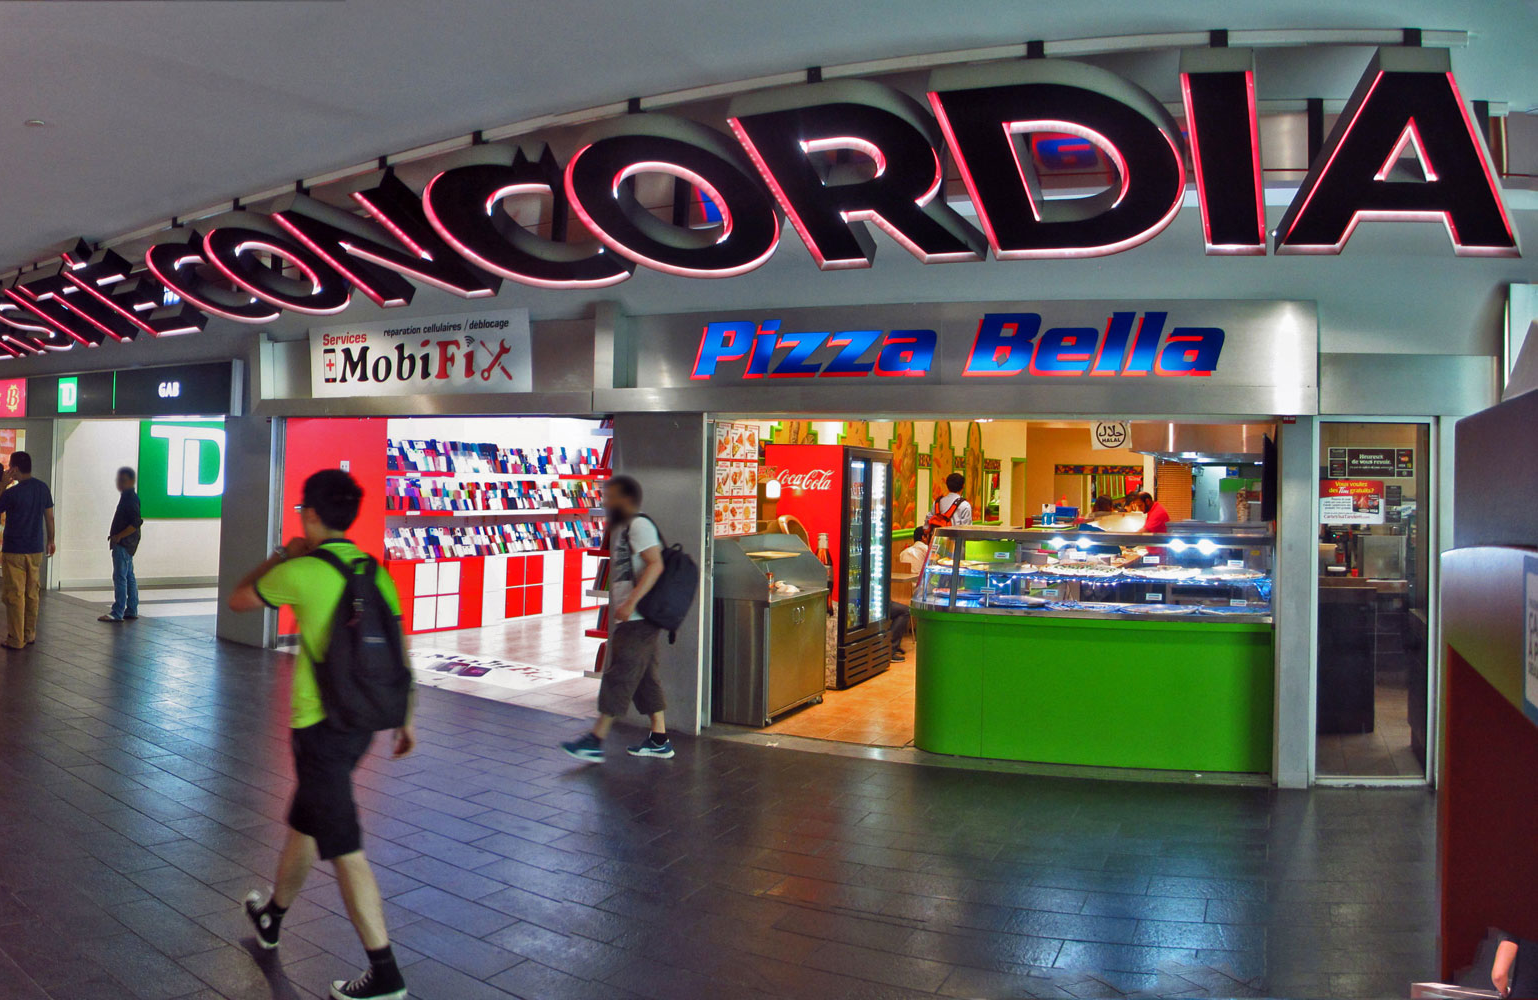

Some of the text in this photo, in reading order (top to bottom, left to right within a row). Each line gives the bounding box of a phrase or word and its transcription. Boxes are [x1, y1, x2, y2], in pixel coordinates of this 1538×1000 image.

[145, 46, 1522, 324] CONCORDIA
[423, 322, 461, 334] cellulaires
[322, 333, 367, 346] Services
[690, 311, 1225, 380] Pizza Bella
[60, 383, 76, 406] TD
[158, 382, 180, 397] GAB
[1099, 425, 1123, 437] حلال
[150, 424, 226, 497] TD
[776, 469, 835, 490] Coca-Cola
